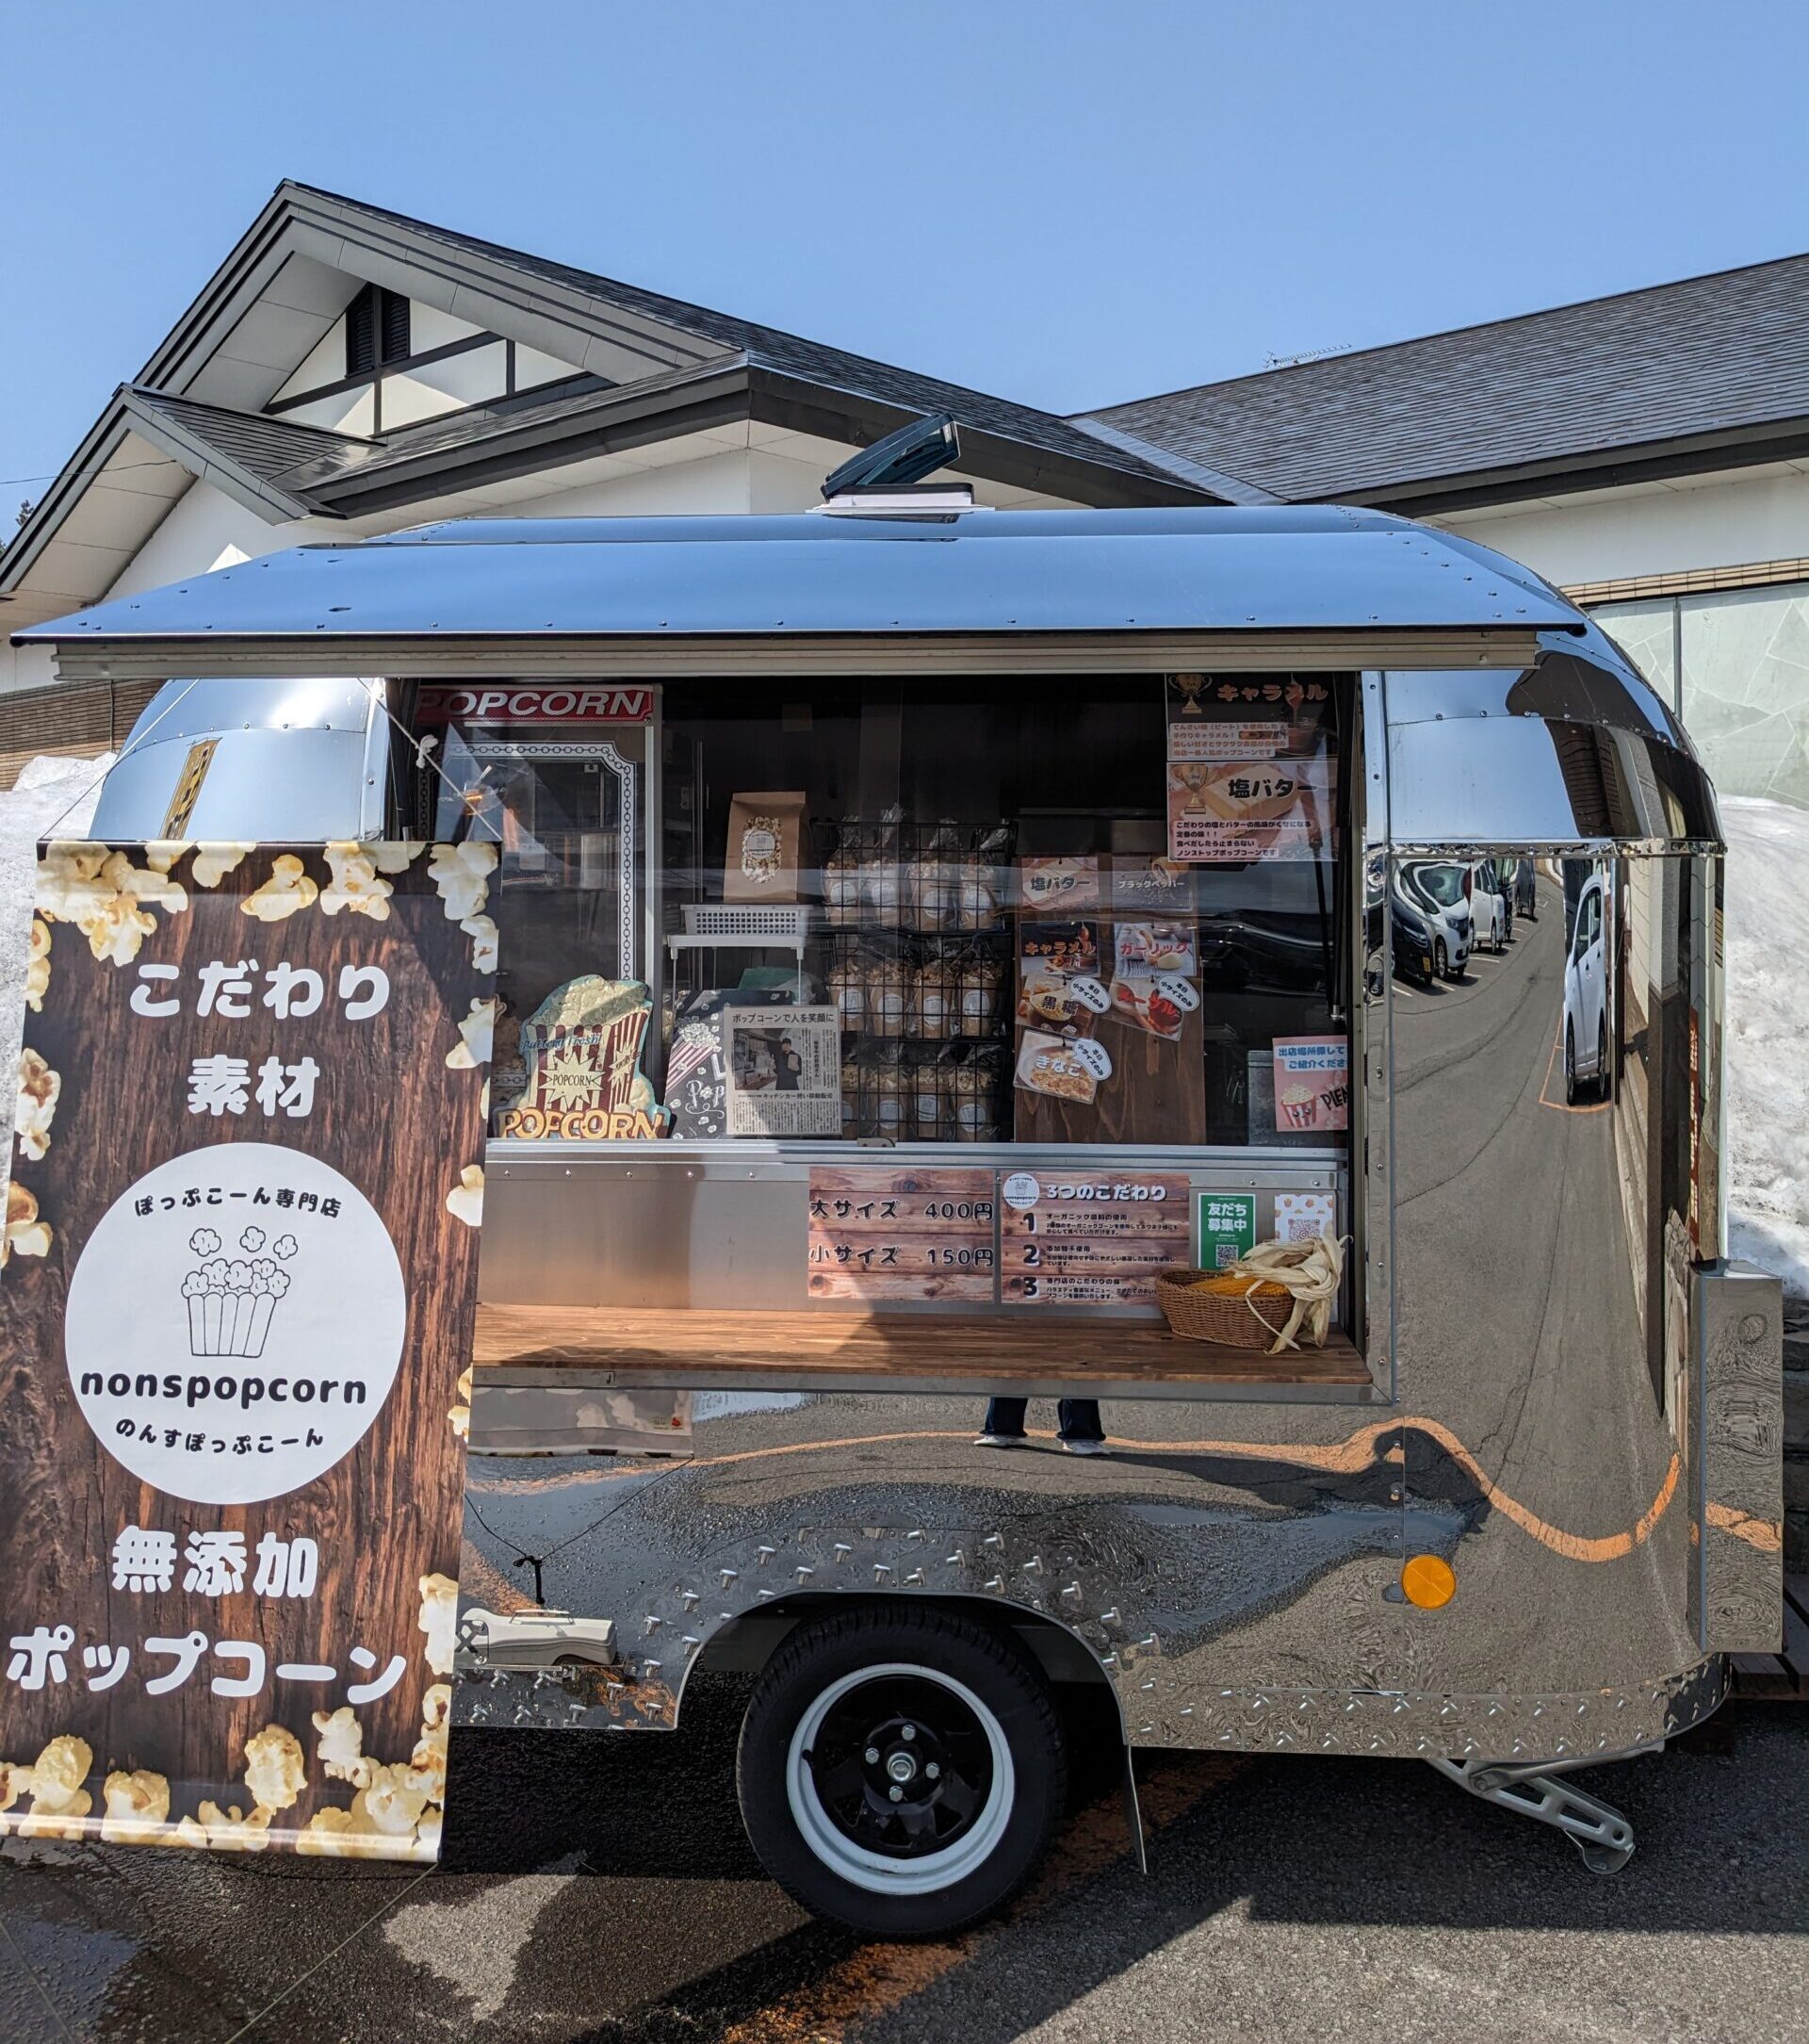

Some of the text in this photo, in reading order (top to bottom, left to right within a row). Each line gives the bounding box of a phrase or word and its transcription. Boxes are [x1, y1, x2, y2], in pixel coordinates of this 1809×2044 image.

[416, 691, 644, 716] POPCORN
[1217, 684, 1328, 702] キャラメル
[1228, 778, 1319, 799] 塩バター
[1030, 876, 1091, 891] 塩バター
[1117, 878, 1185, 889] ブラックペッパー
[1024, 941, 1097, 956] キャラメル
[1120, 942, 1189, 956] ガーリック
[130, 958, 390, 1021] こだわり
[1072, 983, 1104, 1008] 小サイズのみ
[1161, 981, 1193, 1007] 小サイズのみ
[732, 1012, 835, 1023] ポップコーンで人を笑顔に
[1035, 1055, 1082, 1077] きなこ
[1078, 1043, 1104, 1076] 小サイズのみ
[187, 1054, 320, 1118] 素材
[553, 1074, 593, 1087] POPCORN
[497, 1106, 665, 1138] POPCORN
[135, 1186, 342, 1219] ぽっぷこーん専門店
[1047, 1184, 1167, 1202] 3つのこだわり
[810, 1199, 994, 1220] 大サイズ 400円
[1207, 1202, 1247, 1217] 友だち
[1023, 1213, 1035, 1233] 1
[1207, 1218, 1247, 1232] 募集中
[809, 1245, 994, 1267] 小サイズ 150円
[1023, 1244, 1037, 1265] 2
[1023, 1277, 1037, 1297] 3
[80, 1370, 367, 1410] nonspopcorn
[115, 1417, 325, 1456] のんすぽっぷこーん
[111, 1525, 318, 1598] 無添加
[6, 1624, 407, 1705] ポップコーン
